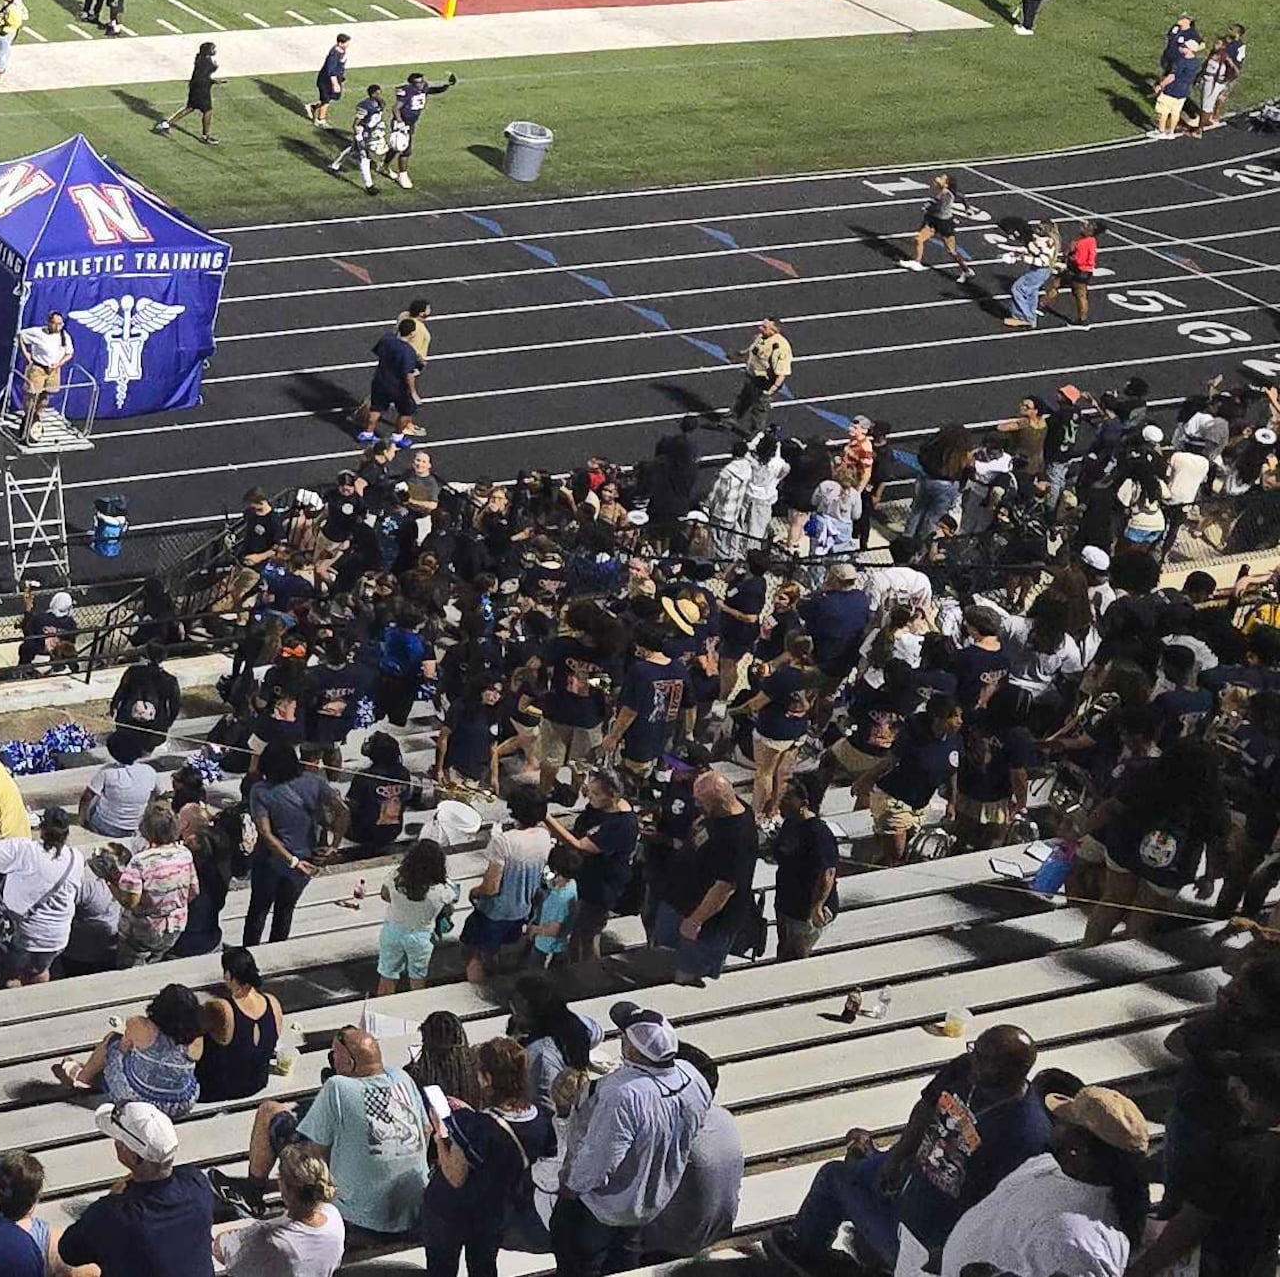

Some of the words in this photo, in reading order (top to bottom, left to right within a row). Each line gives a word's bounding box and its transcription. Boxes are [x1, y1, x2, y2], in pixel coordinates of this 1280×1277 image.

[68, 183, 154, 245] N
[33, 253, 124, 279] ATHLETIC
[135, 251, 224, 272] TRAINING
[1107, 289, 1188, 313] 5
[1177, 321, 1253, 346] 6
[104, 339, 144, 381] N
